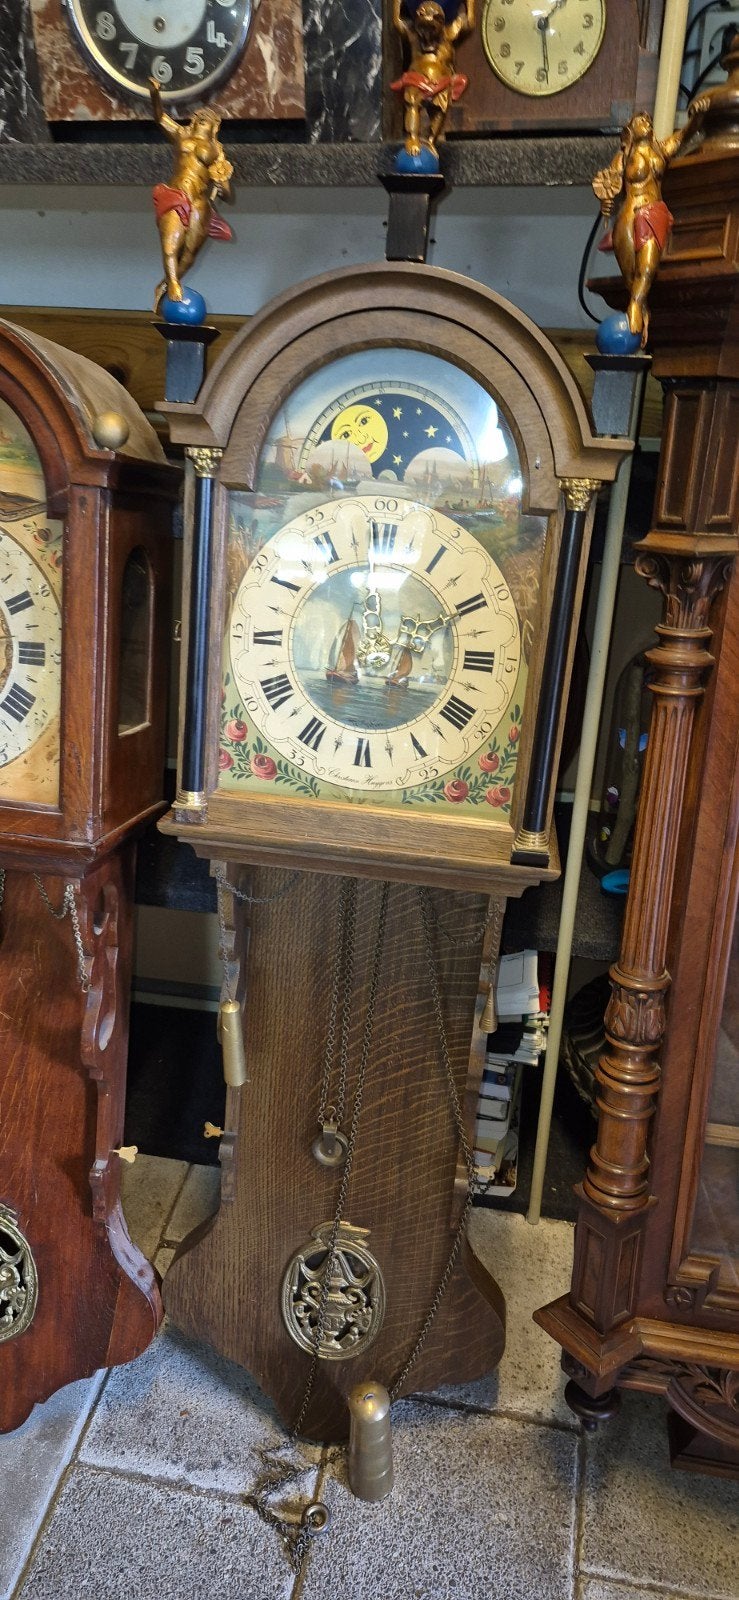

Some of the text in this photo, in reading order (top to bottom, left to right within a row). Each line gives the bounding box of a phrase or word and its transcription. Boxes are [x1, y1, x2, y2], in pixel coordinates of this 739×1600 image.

[95, 11, 117, 41] 8
[582, 14, 594, 30] 3
[206, 20, 228, 48] 4
[119, 42, 139, 70] 7
[500, 42, 511, 58] 8
[573, 41, 586, 56] 4
[151, 56, 173, 84] 6
[183, 46, 205, 75] 5
[514, 61, 525, 76] 7
[557, 60, 569, 76] 5
[535, 67, 548, 83] 6
[374, 498, 398, 512] 60
[306, 509, 324, 526] 55
[450, 527, 462, 539] 5
[252, 554, 269, 574] 50
[425, 543, 449, 575] I
[494, 583, 510, 601] 10
[4, 590, 36, 616] II
[454, 590, 489, 620] II
[18, 641, 46, 667] III
[462, 648, 496, 676] III
[505, 657, 518, 674] 15
[0, 682, 37, 723] IIII
[259, 672, 295, 713] VIII
[439, 693, 478, 733] IIII
[296, 715, 328, 752] VII
[474, 721, 494, 740] 20
[287, 748, 305, 766] 35
[419, 766, 440, 781] 25
